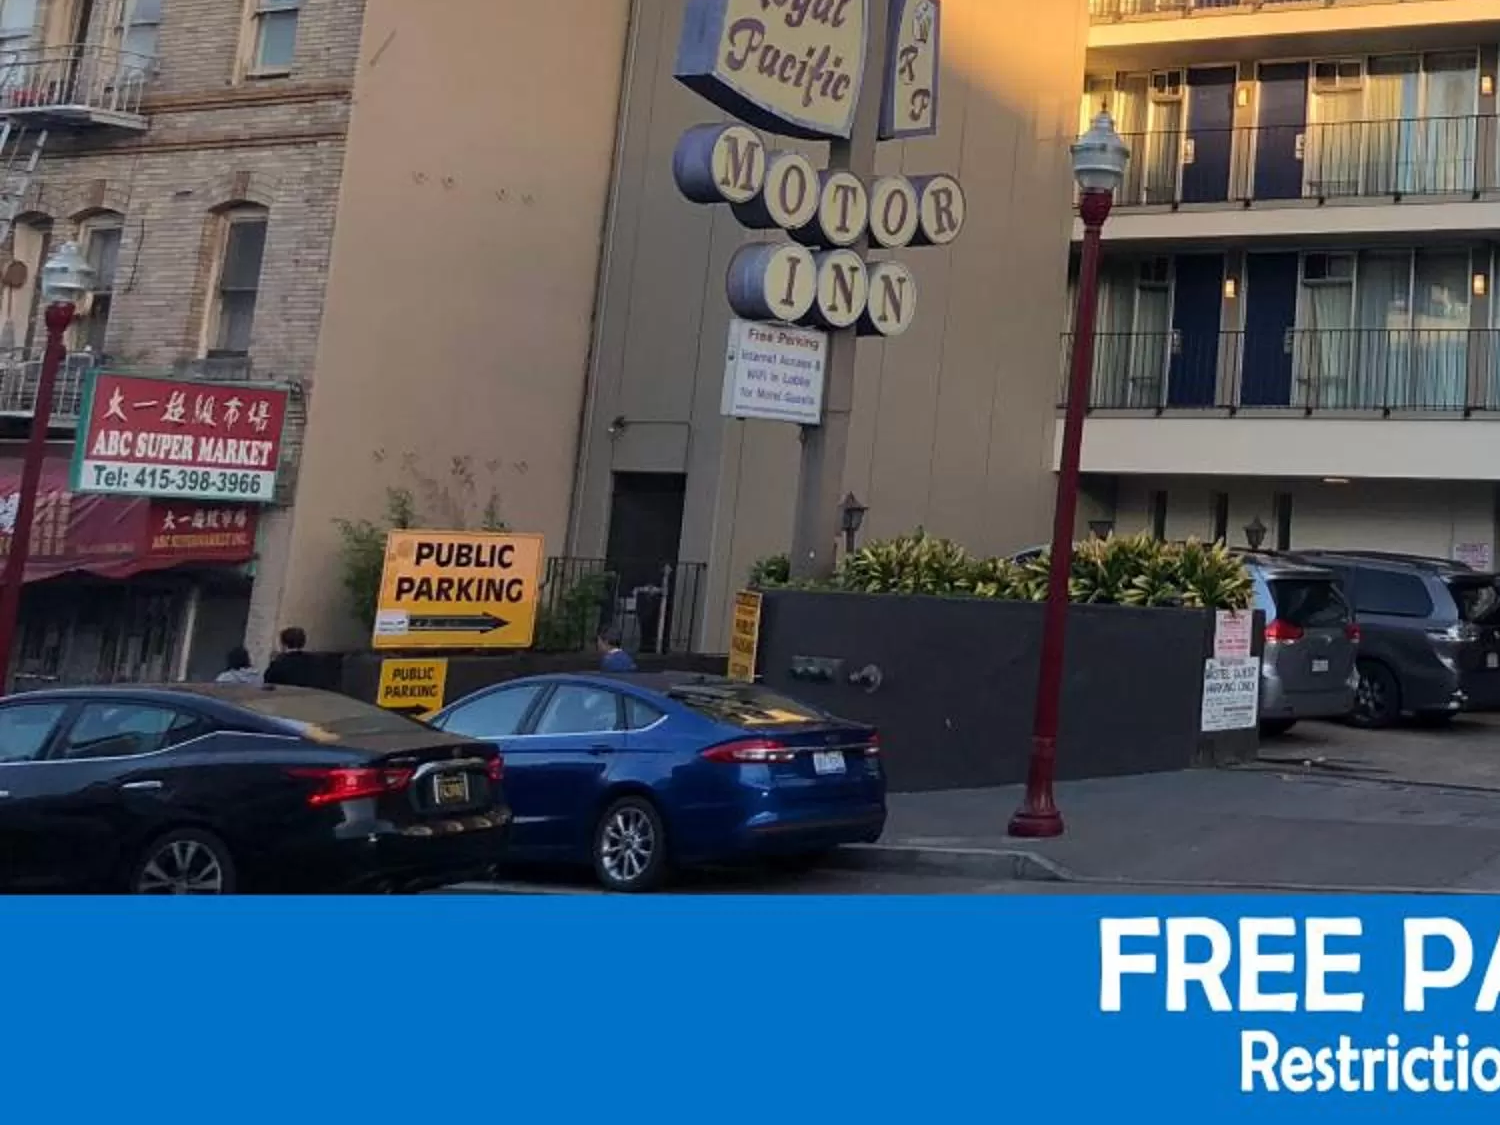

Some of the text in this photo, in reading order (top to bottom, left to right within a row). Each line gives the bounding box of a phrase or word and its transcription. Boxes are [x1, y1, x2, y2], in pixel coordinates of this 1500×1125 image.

[725, 17, 850, 107] Pacific
[720, 135, 959, 236] MOTOR
[780, 256, 907, 324] INN
[748, 328, 820, 352] Free Parking
[92, 429, 273, 466] ABC SUPER MARKET
[93, 464, 261, 495] Tel: 415-398-3966
[414, 542, 515, 569] PUBLIC
[395, 576, 524, 604] PARKING
[391, 666, 435, 682] PUBLIC
[384, 684, 439, 700] PARKING
